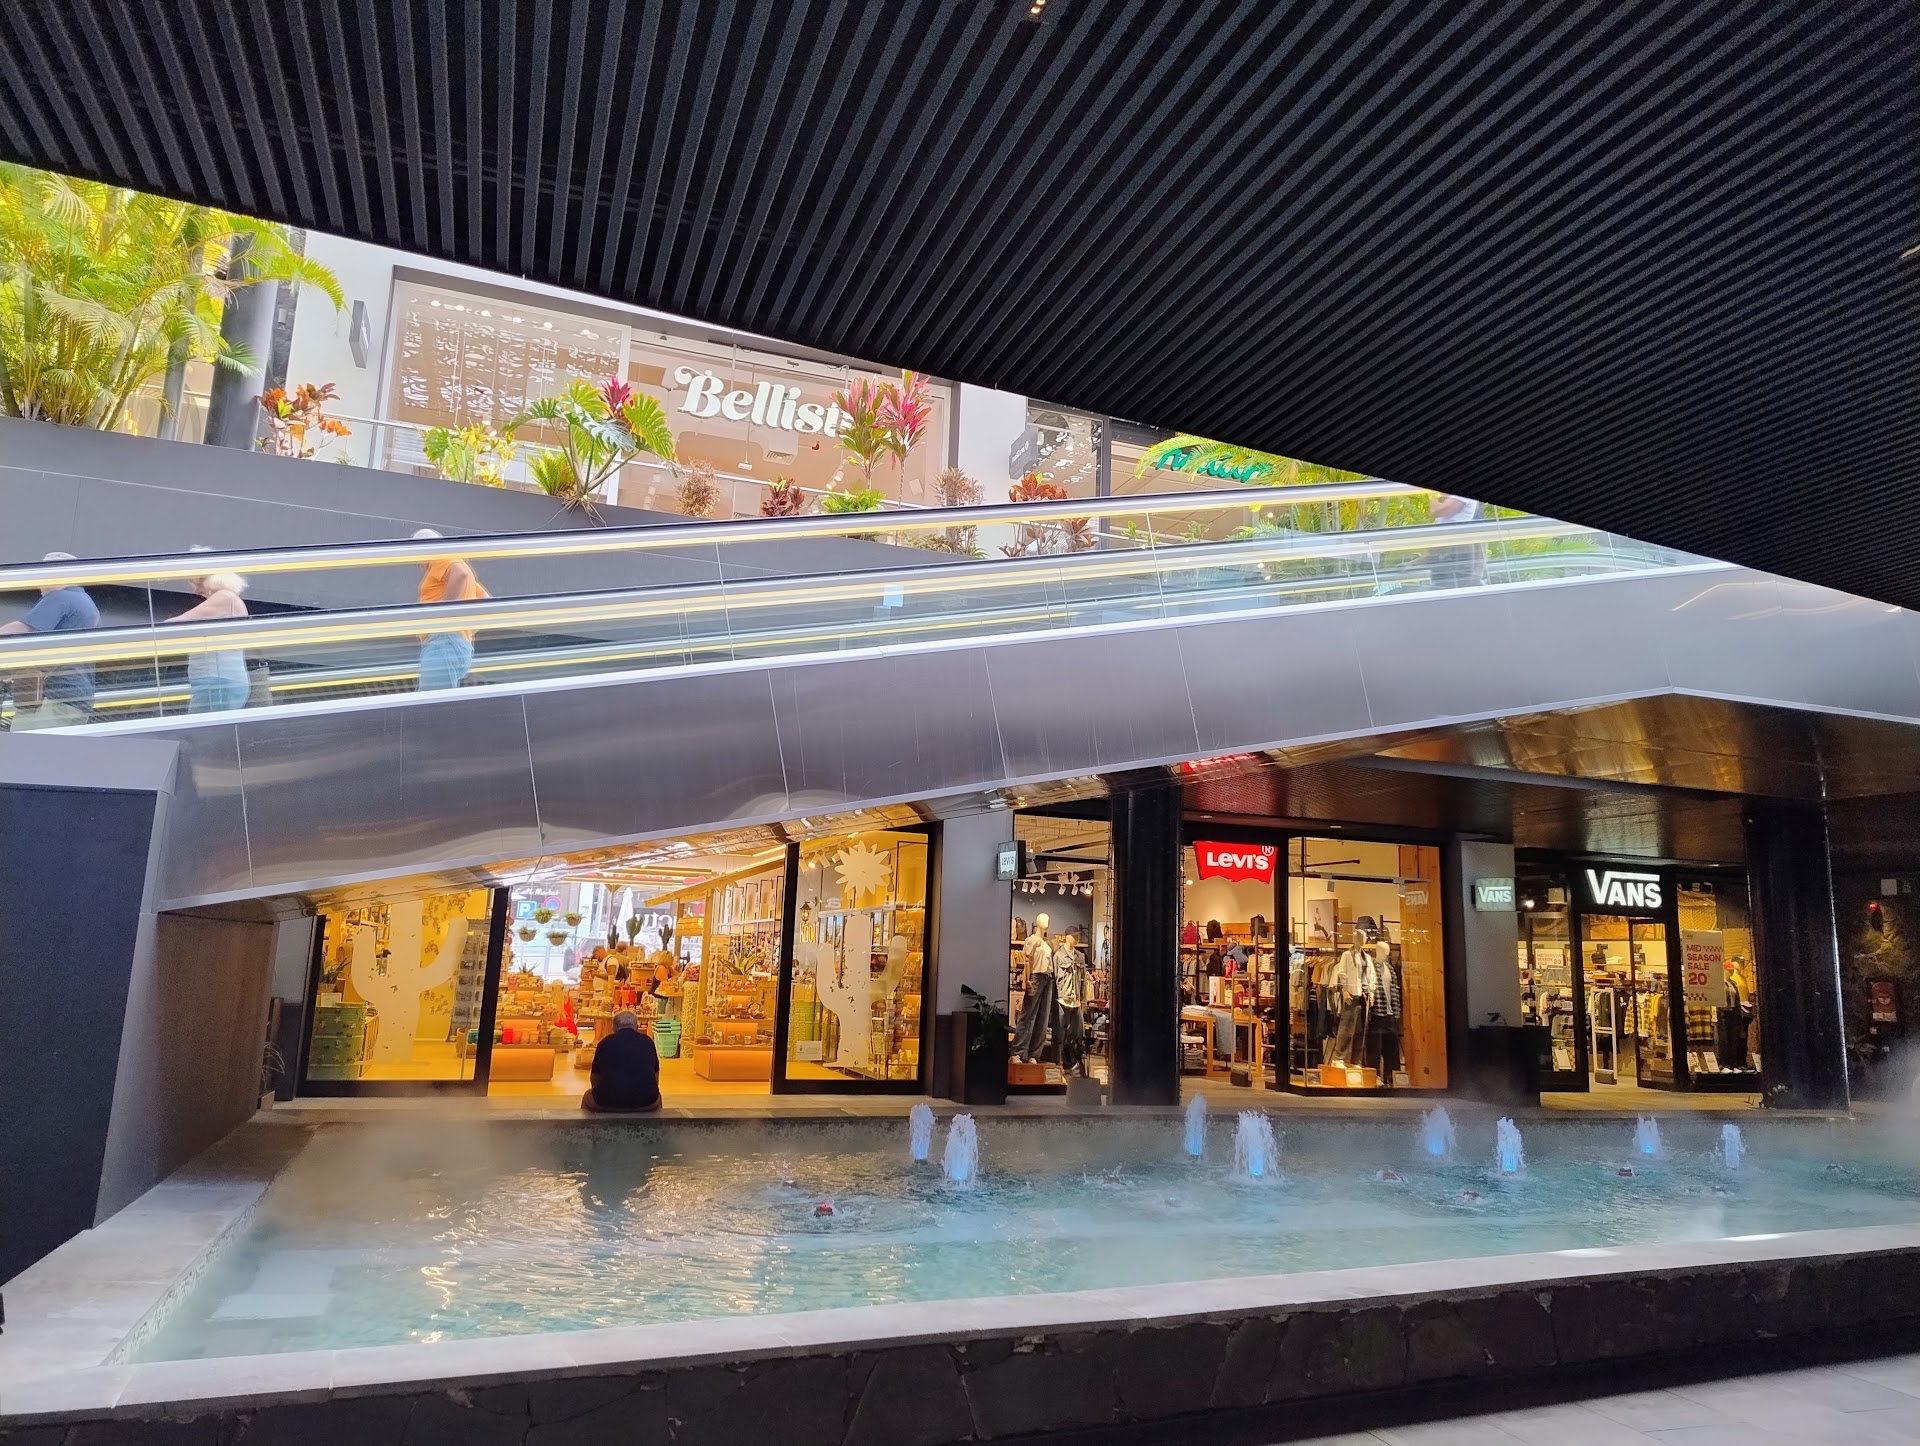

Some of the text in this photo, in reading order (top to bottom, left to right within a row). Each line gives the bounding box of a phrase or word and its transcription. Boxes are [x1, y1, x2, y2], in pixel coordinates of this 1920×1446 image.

[1478, 886, 1512, 903] VANS
[1585, 869, 1662, 908] VANS
[518, 903, 531, 917] P
[1686, 944, 1702, 952] MID
[1687, 953, 1721, 962] SEASON
[1688, 962, 1710, 971] SALE
[1688, 972, 1708, 986] 20
